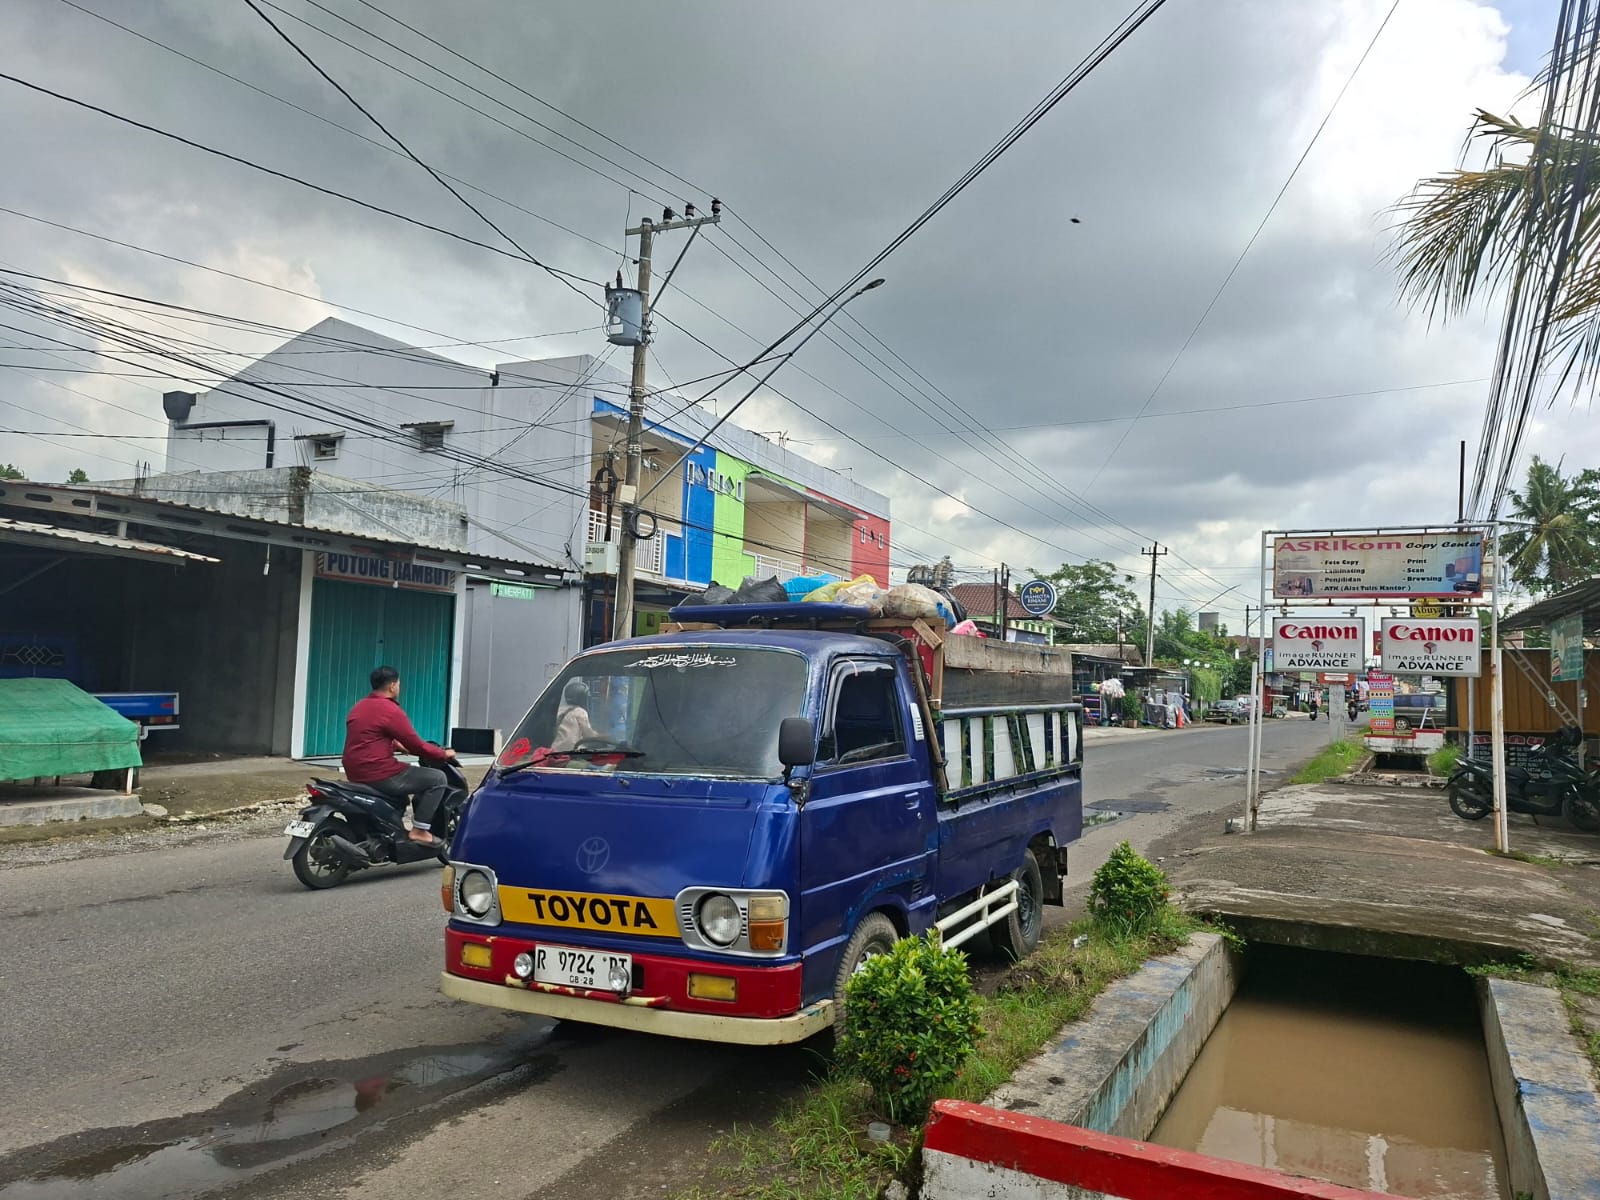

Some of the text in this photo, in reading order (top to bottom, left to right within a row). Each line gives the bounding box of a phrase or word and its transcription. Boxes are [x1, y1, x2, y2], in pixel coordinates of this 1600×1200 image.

[1278, 539, 1401, 552] ASRIkom
[327, 552, 390, 578] POTONG
[1279, 624, 1358, 640] Canon
[1389, 624, 1474, 643] Canon
[1287, 659, 1349, 667] ADVANCE
[1388, 654, 1473, 662] imageRUNNER
[1397, 662, 1464, 671] ADVANCE
[527, 893, 658, 929] TOYOTA
[537, 949, 546, 970] R
[558, 951, 595, 975] 9724
